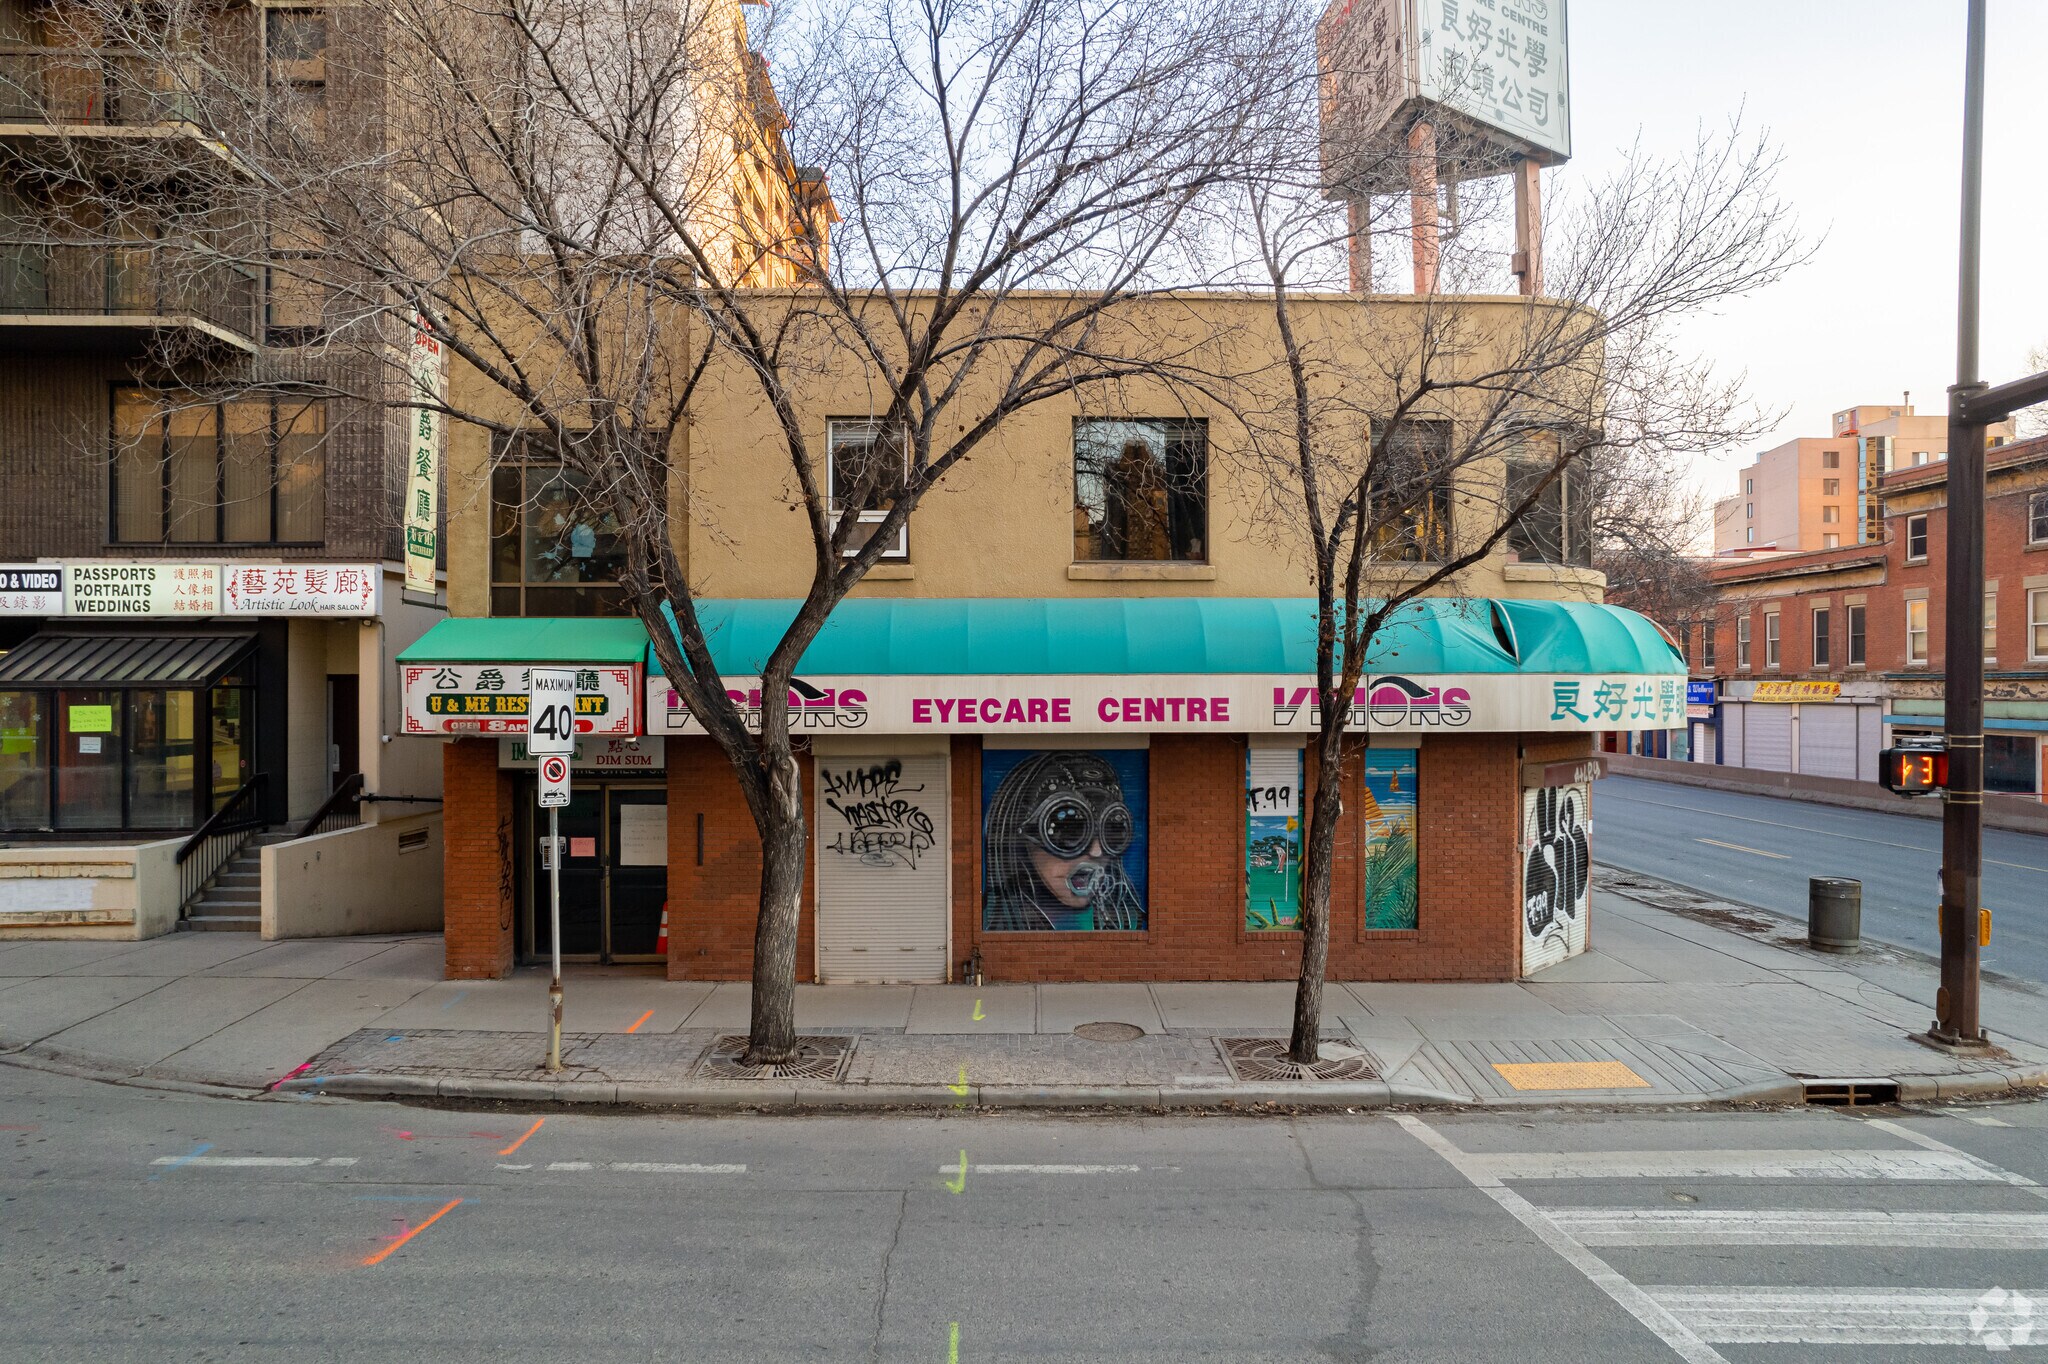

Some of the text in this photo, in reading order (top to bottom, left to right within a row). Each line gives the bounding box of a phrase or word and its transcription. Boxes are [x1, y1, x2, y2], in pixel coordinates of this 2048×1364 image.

[1501, 5, 1548, 37] CENTRE
[416, 331, 439, 356] OPEN
[10, 573, 19, 589] &
[22, 573, 57, 589] VIDEO
[74, 568, 156, 581] PASSPORTS
[173, 568, 213, 580] 護照相
[242, 568, 359, 595] 藝苑髮廊
[74, 584, 152, 597] PORTRAITS
[173, 583, 213, 596] 人像相
[75, 600, 151, 613] WEDDINGS
[173, 599, 214, 612] 結婚相
[240, 598, 285, 611] Artistic
[288, 597, 320, 613] Look
[432, 668, 600, 692] 公爵廳
[535, 678, 573, 692] MAXIMUM
[431, 696, 442, 712] U
[446, 698, 459, 712] &
[464, 696, 490, 712] ME
[912, 697, 1230, 723] EYECARE CENTRE
[450, 722, 480, 731] OPEN
[533, 705, 572, 740] 40
[596, 755, 652, 765] DIM SUM
